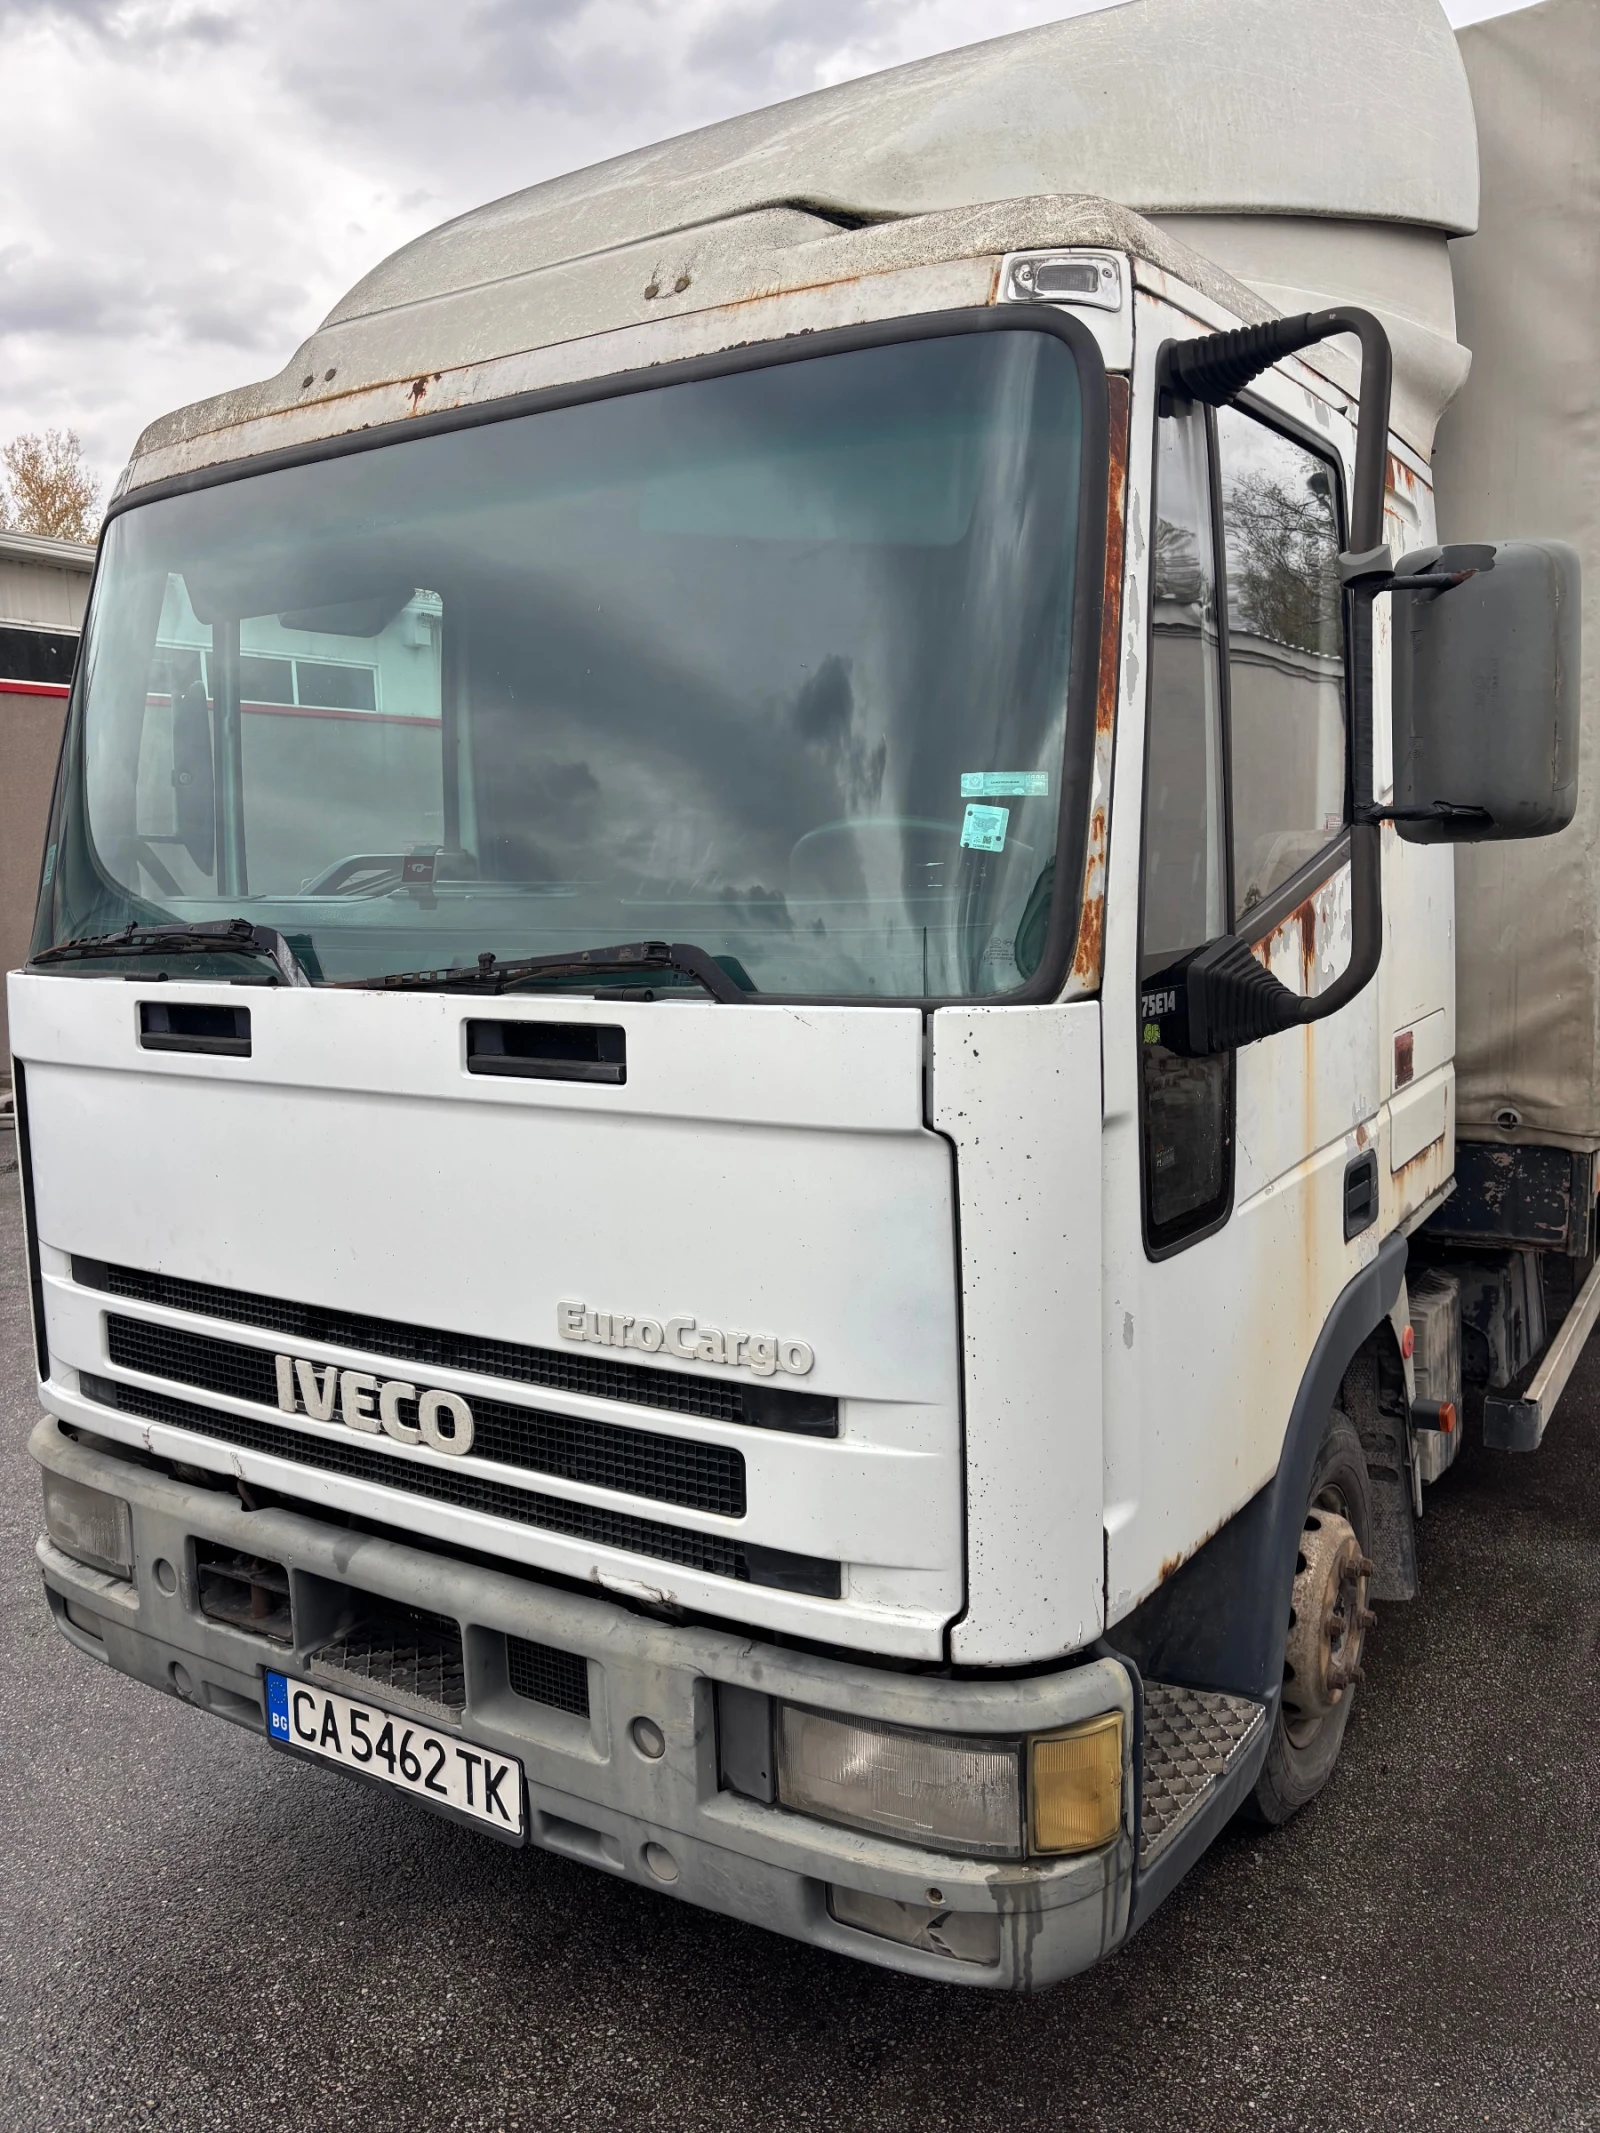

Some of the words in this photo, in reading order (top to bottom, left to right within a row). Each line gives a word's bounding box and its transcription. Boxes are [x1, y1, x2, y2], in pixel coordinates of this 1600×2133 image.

[1141, 990, 1176, 1018] 75E14
[557, 1300, 814, 1376] EuroCargo
[275, 1355, 475, 1455] IVECO
[272, 1712, 288, 1731] BG
